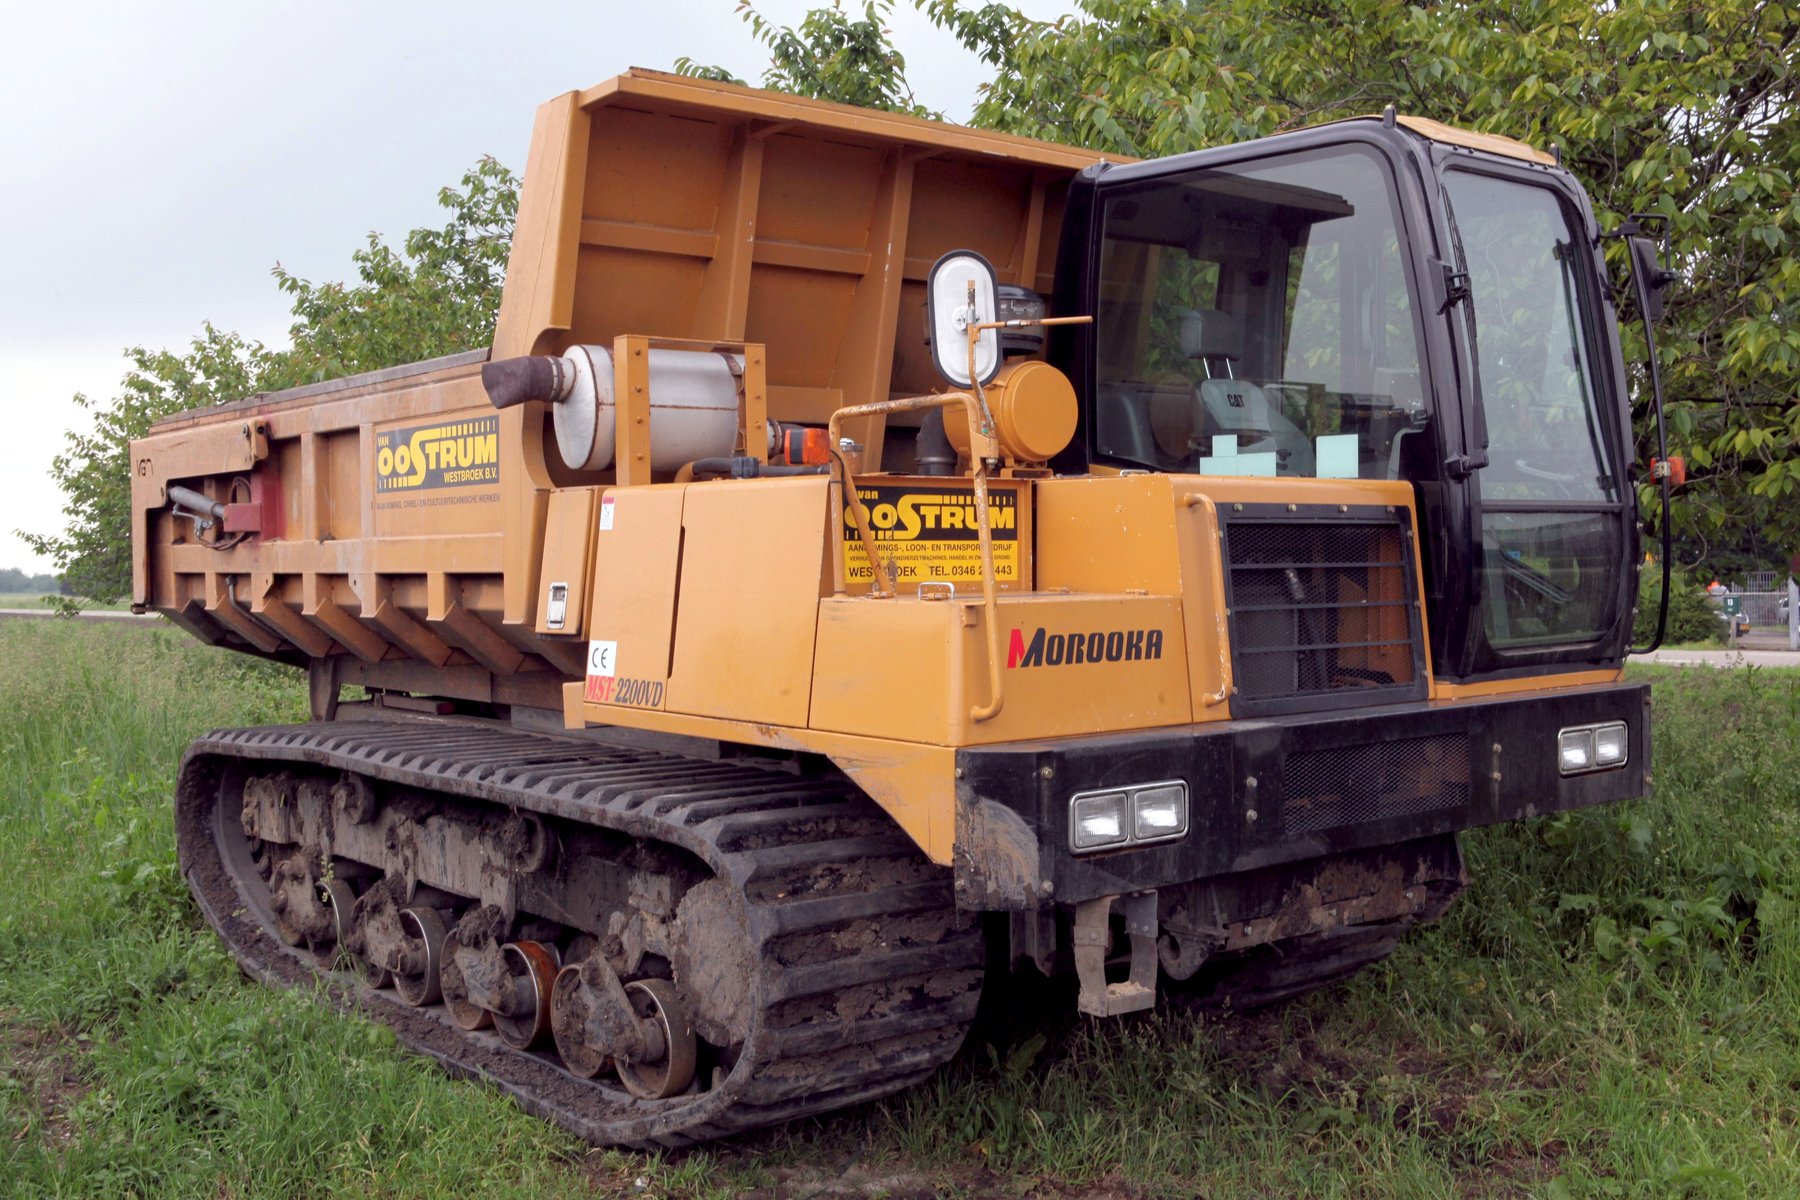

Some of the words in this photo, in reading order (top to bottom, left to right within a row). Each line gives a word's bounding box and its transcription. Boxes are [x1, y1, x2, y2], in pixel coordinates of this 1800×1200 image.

[1226, 393, 1245, 408] CAT
[378, 436, 389, 446] VAN
[444, 469, 485, 483] WESTBROEK
[485, 467, 498, 480] B.V.
[857, 490, 879, 499] van
[905, 544, 930, 552] LOON-
[929, 565, 950, 576] TEL.
[951, 565, 976, 576] 0346
[1007, 627, 1163, 669] MOROOKA
[592, 647, 608, 669] CE
